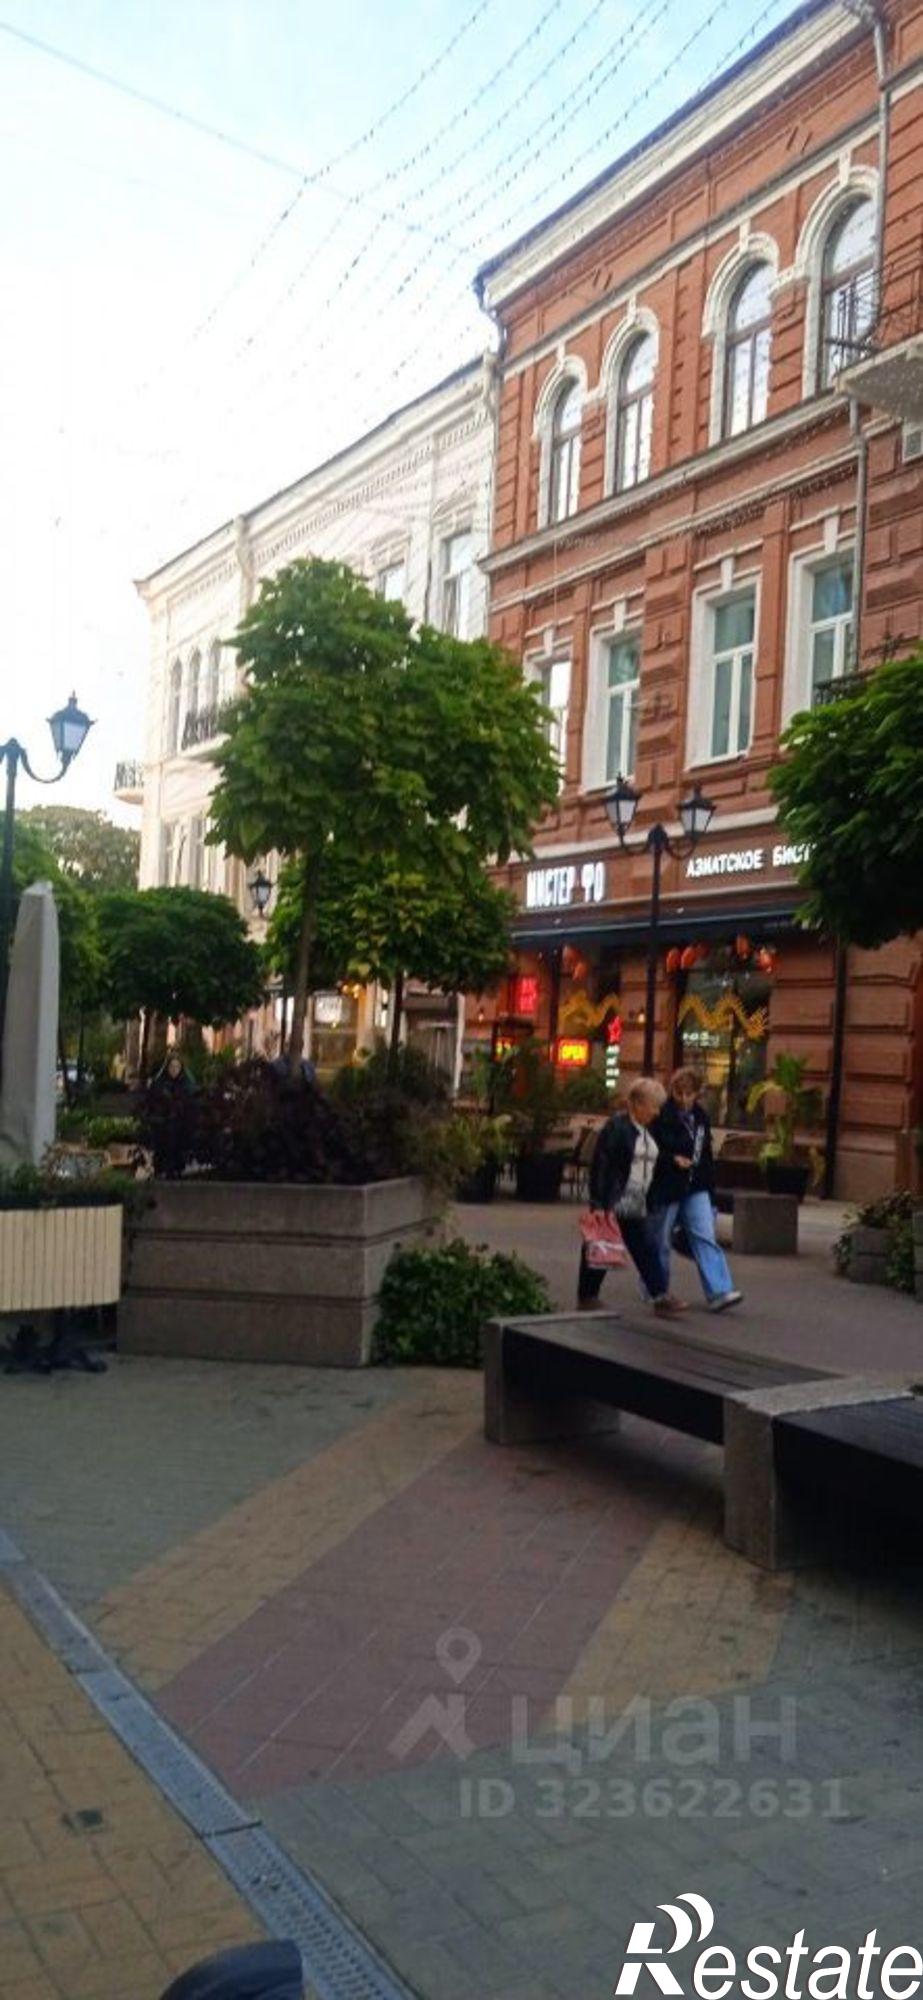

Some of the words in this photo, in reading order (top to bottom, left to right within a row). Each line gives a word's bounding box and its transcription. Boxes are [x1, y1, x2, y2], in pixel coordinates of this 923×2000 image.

[686, 849, 763, 878] АЗИАТСКОЕ
[526, 867, 575, 908] МИСТЕР
[581, 862, 605, 903] ФО
